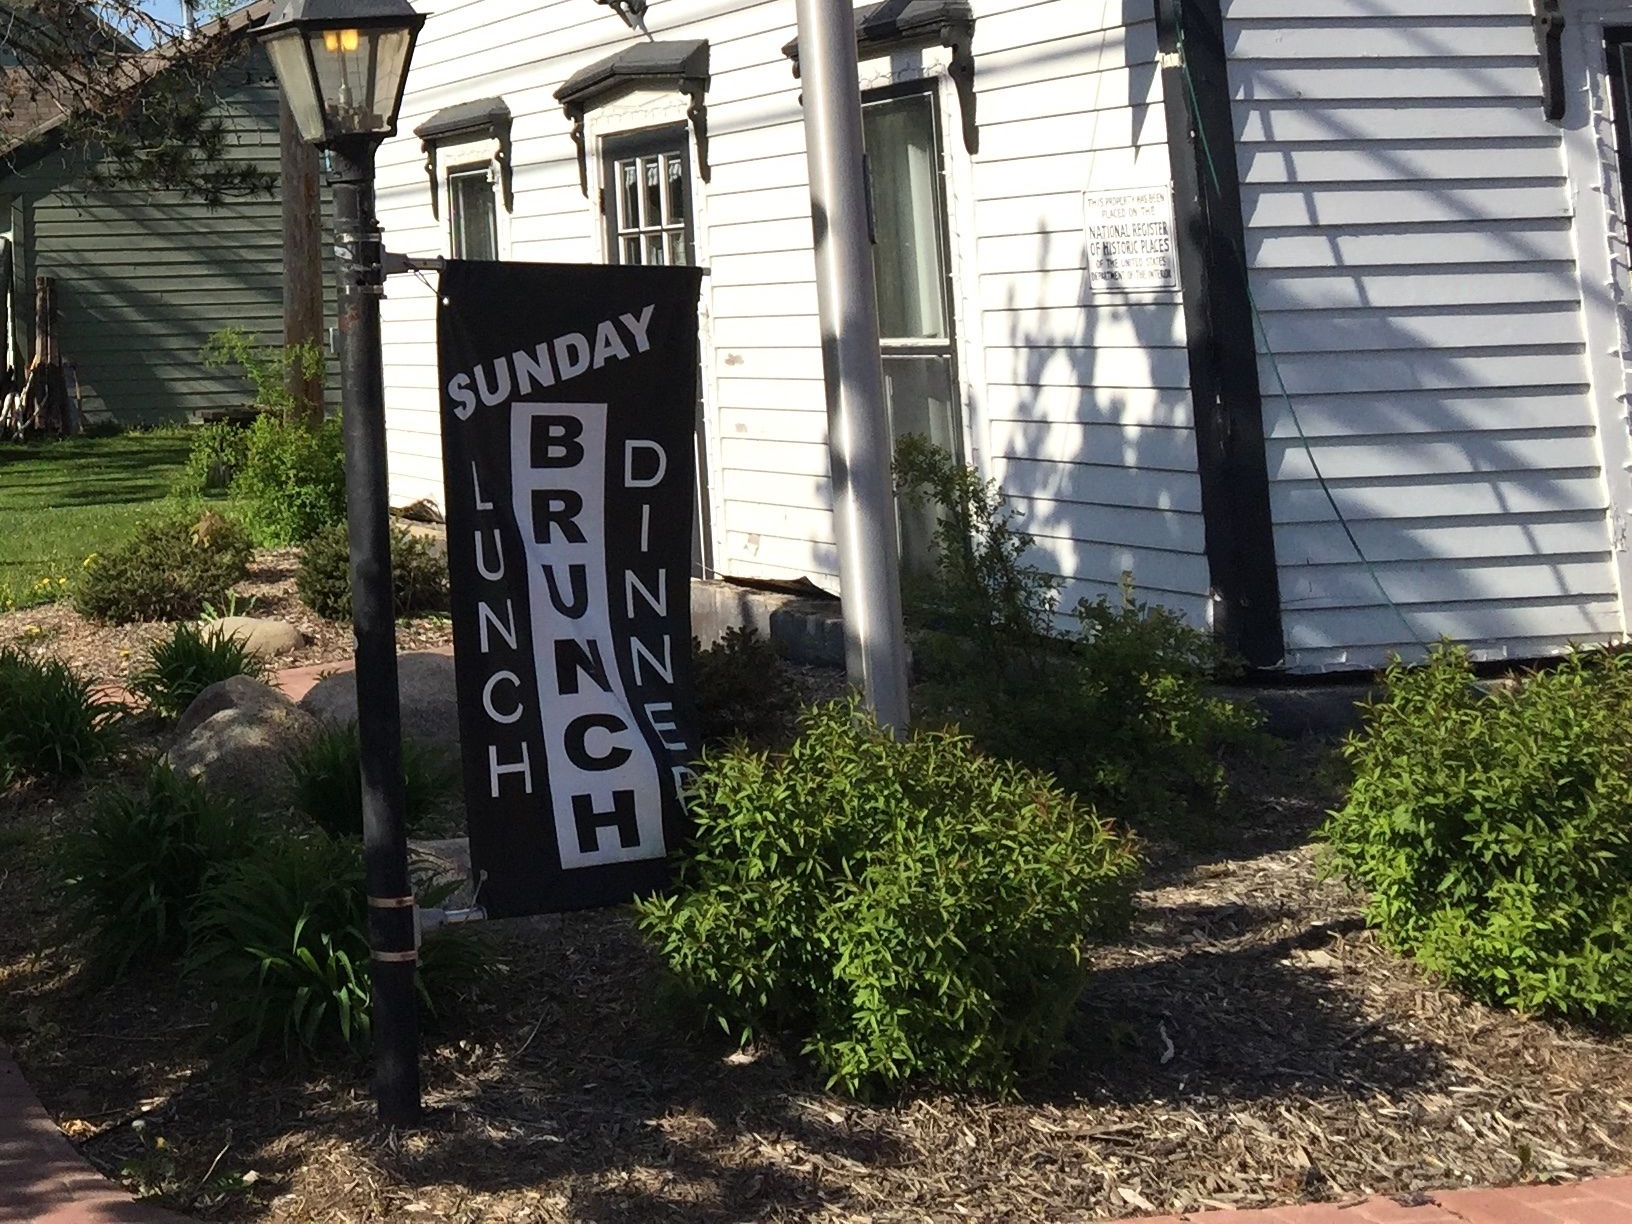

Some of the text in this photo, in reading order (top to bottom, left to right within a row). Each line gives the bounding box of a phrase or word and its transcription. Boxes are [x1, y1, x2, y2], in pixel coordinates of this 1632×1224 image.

[1089, 221, 1169, 239] NATIONAL REGISTER
[1090, 238, 1170, 256] OF HISTORIC PLACES
[448, 303, 657, 422] SUNDAY
[471, 460, 533, 798] LUNCH
[529, 414, 642, 855] BRUNCH
